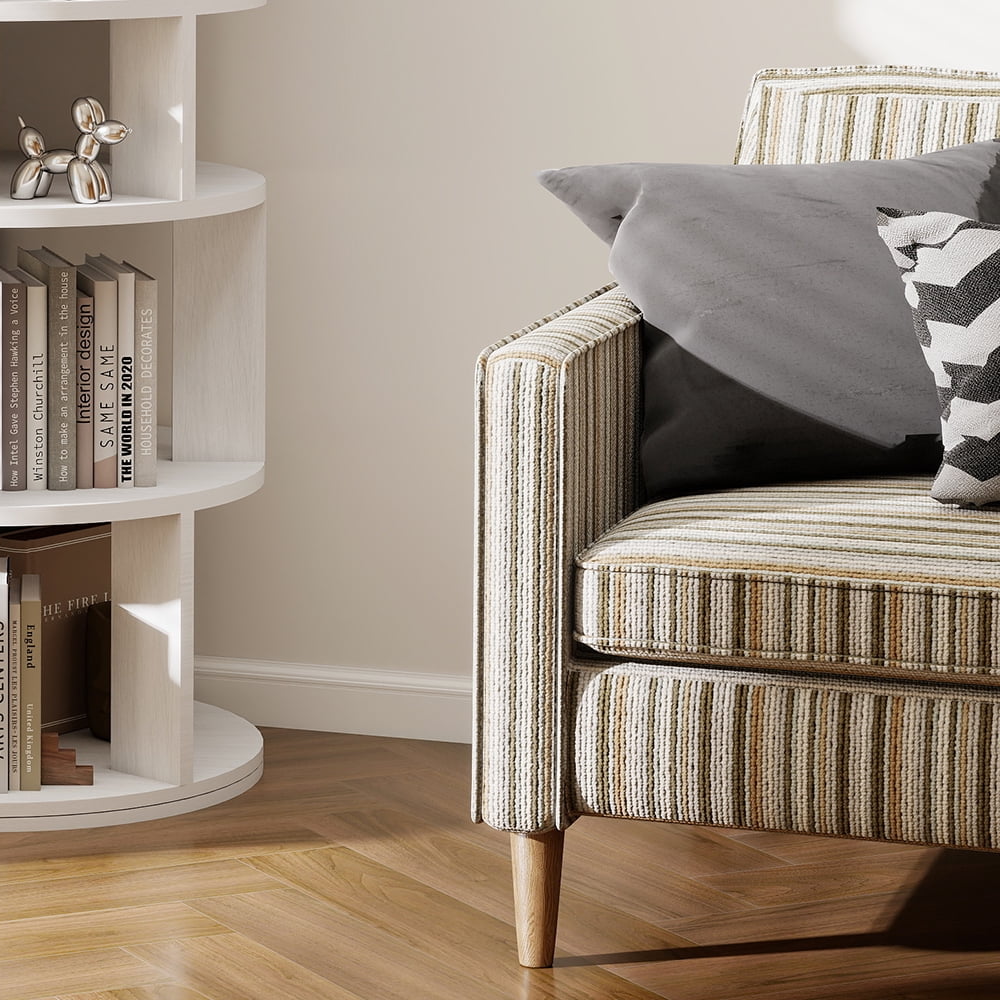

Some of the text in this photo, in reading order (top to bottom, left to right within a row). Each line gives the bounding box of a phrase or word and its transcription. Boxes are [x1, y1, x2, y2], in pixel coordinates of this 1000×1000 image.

[10, 288, 18, 314] Voice
[10, 329, 20, 367] Hawking
[76, 303, 94, 424] Interior design
[10, 370, 20, 409] Stephen
[59, 271, 71, 482] How to make an arrangement in the house
[100, 344, 114, 448] SAME SAME
[141, 307, 152, 456] HOUSEHOLD DECORATES
[10, 412, 18, 435] Gave
[33, 353, 43, 482] Winston Churchill
[121, 356, 132, 483] THE WORLD IN 2020
[10, 439, 18, 466] Intel
[10, 472, 18, 487] How
[41, 602, 62, 617] HE
[24, 624, 35, 669] England
[25, 734, 33, 773] Kingdom
